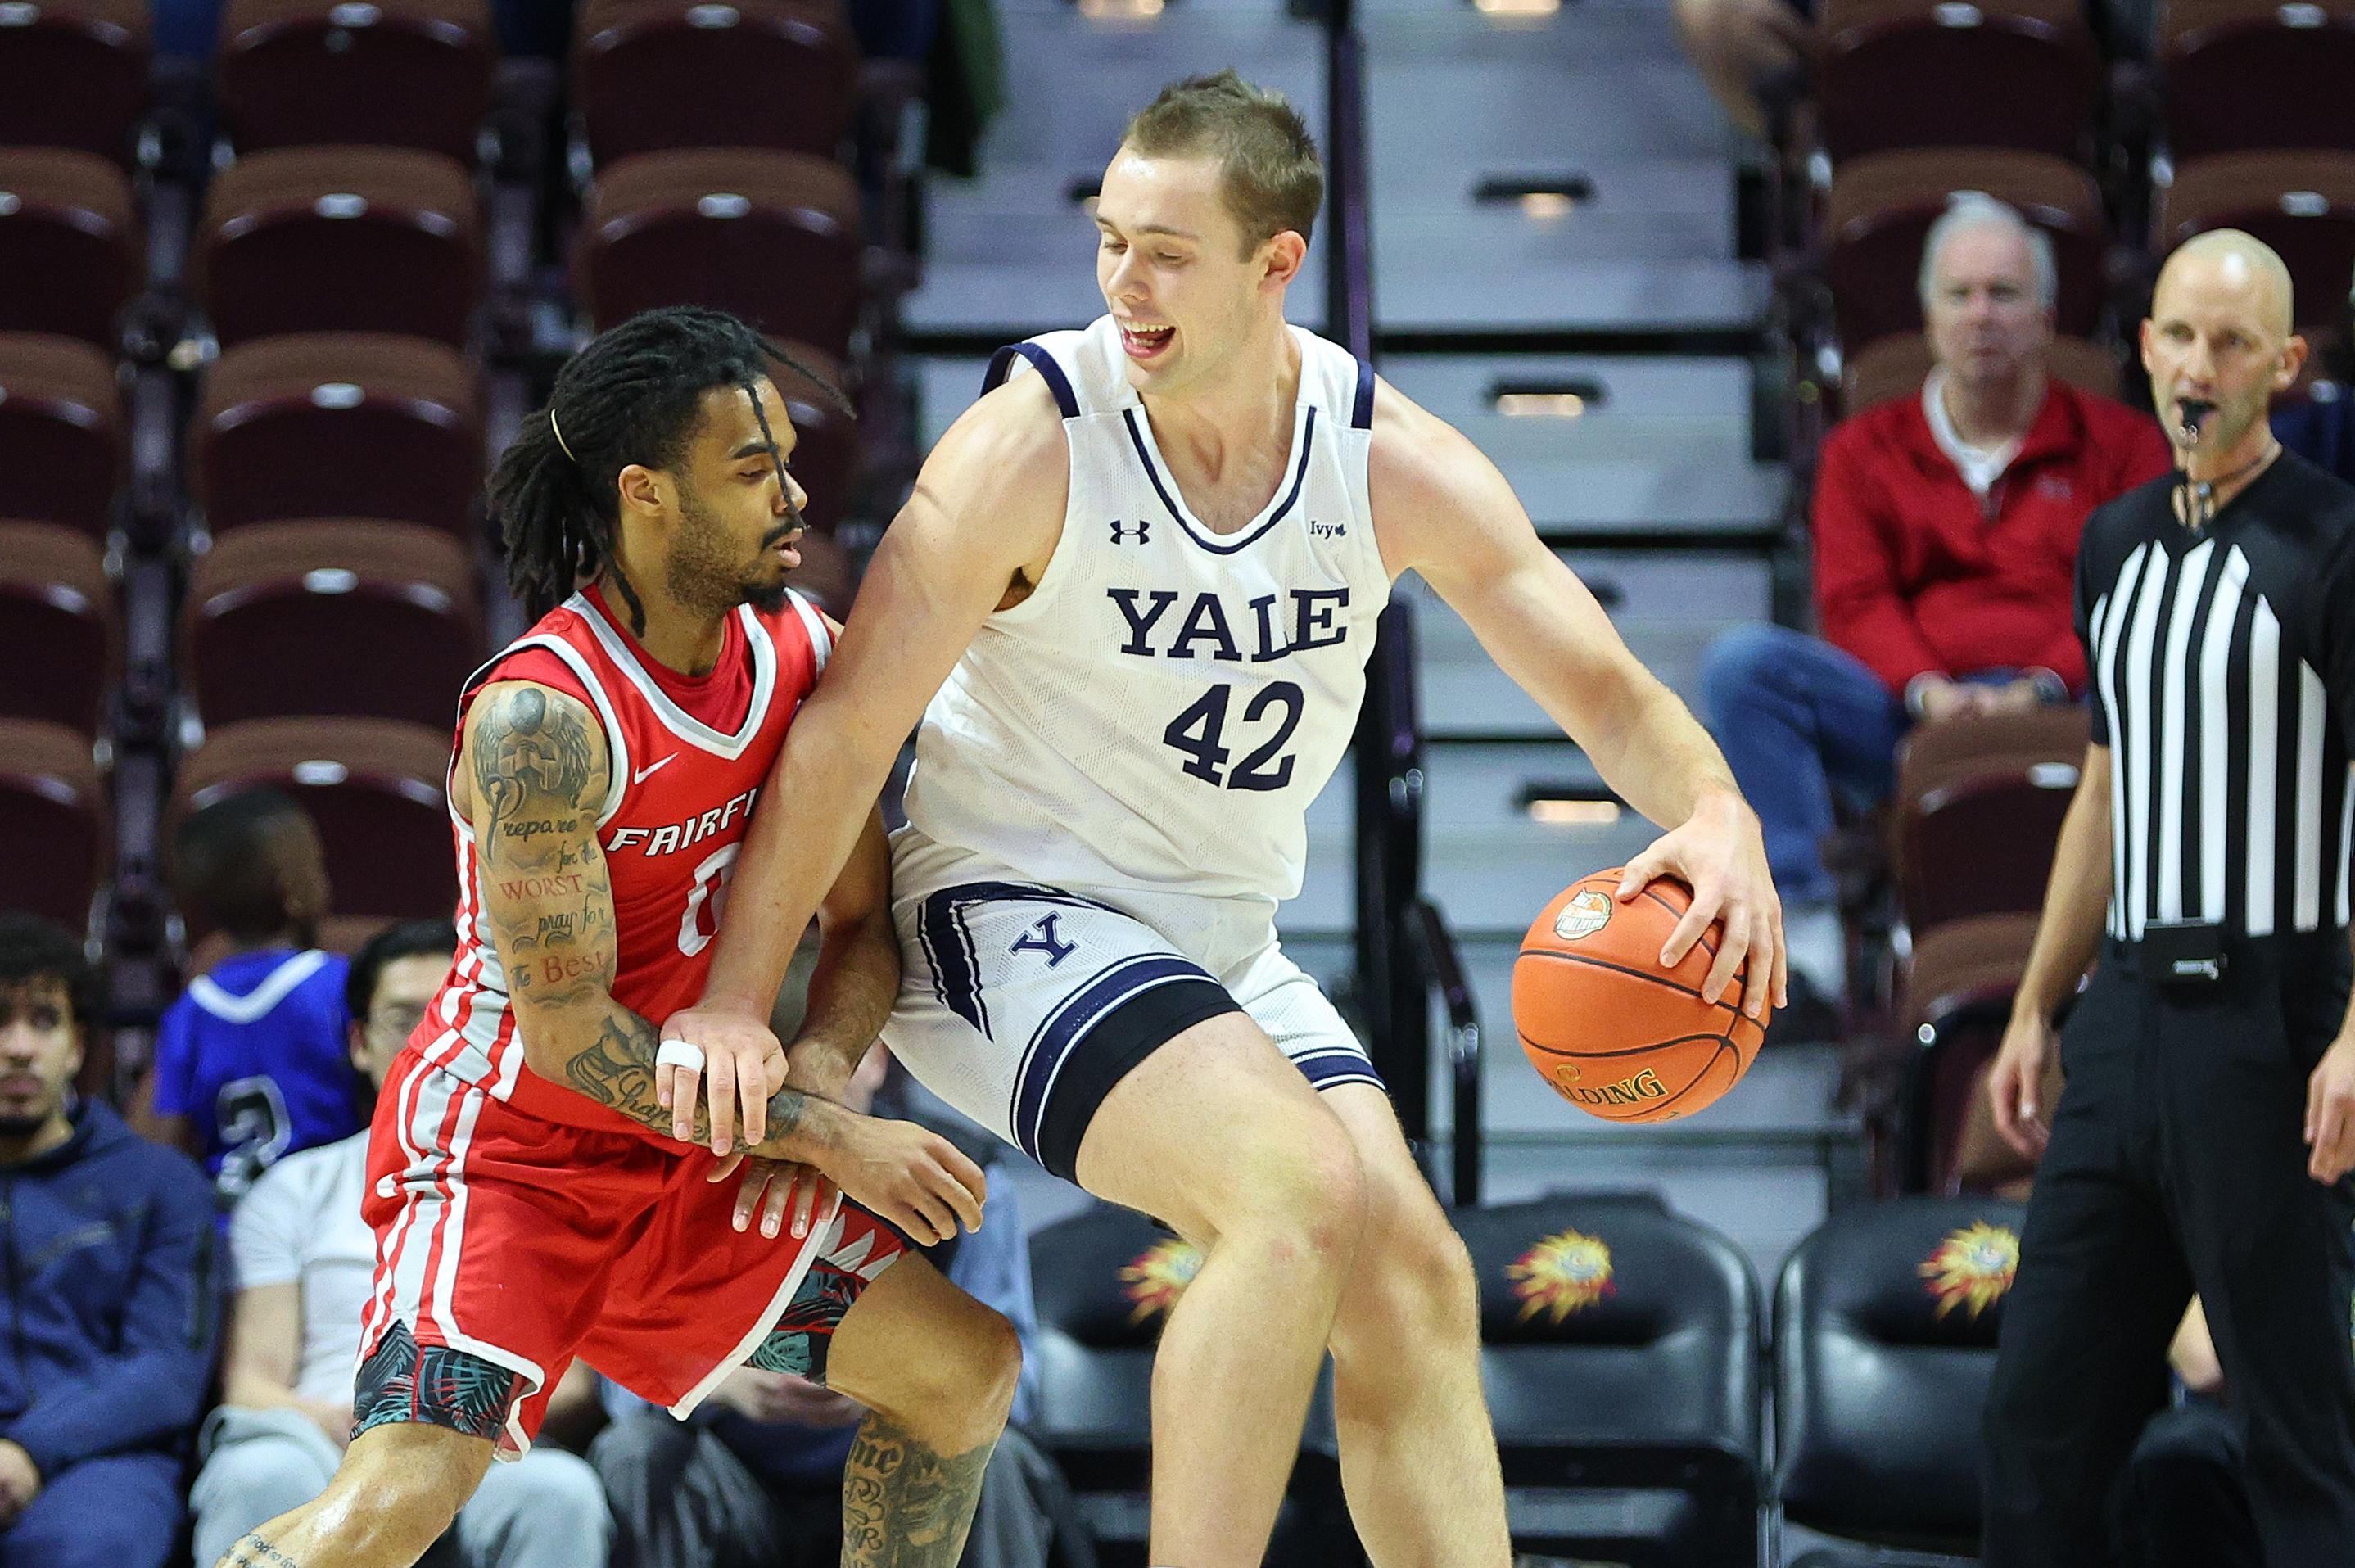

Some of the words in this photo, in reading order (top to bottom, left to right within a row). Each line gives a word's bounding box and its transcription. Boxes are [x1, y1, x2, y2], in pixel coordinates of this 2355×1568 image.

[1310, 520, 1334, 540] Ivy
[1106, 587, 1349, 662] YALE
[1163, 680, 1304, 791] 42
[499, 874, 583, 901] WORST
[536, 911, 578, 942] pray
[581, 893, 604, 934] for
[1008, 910, 1079, 970] Y
[542, 951, 604, 985] Best
